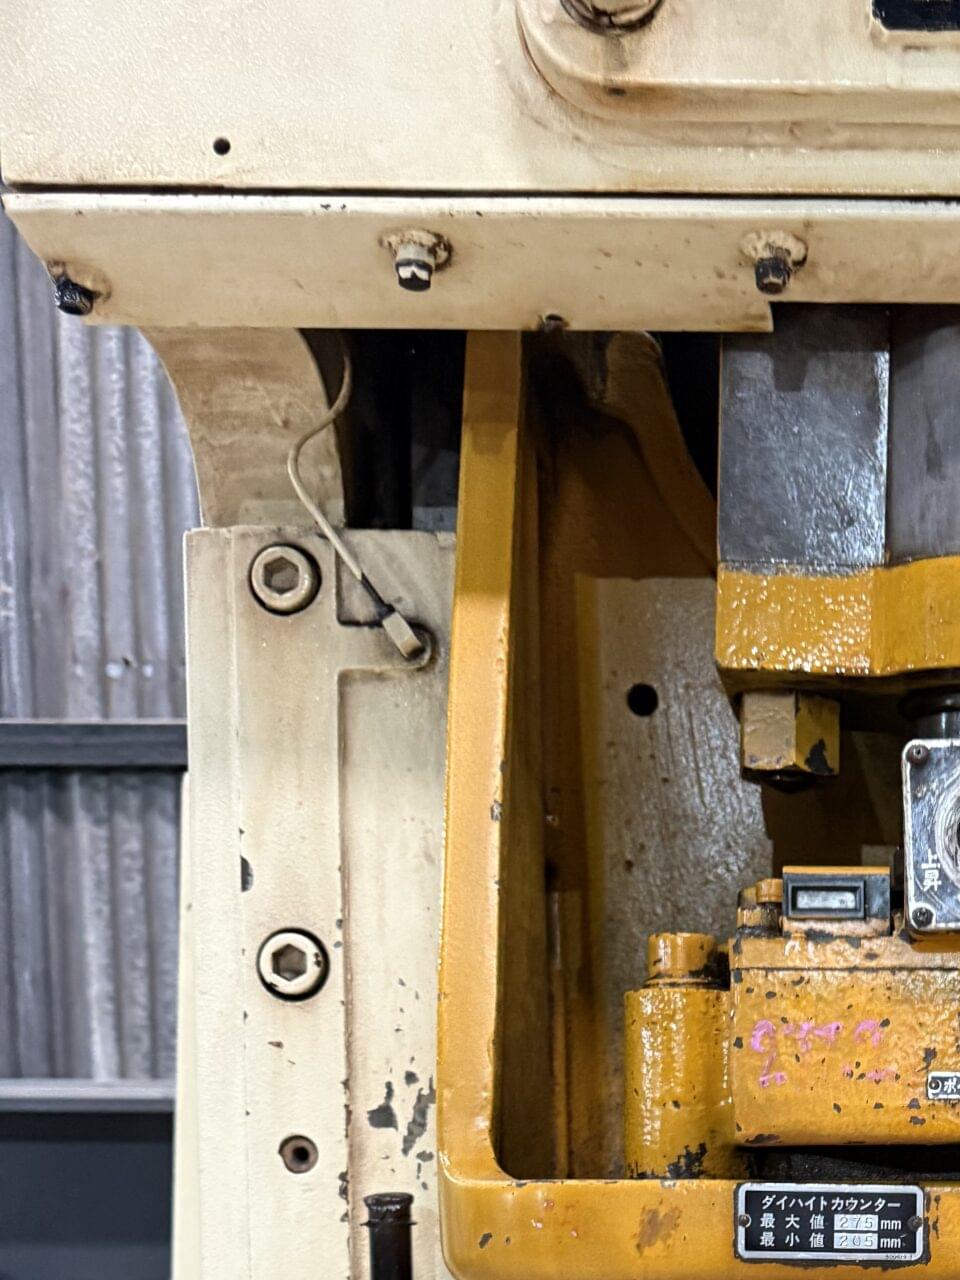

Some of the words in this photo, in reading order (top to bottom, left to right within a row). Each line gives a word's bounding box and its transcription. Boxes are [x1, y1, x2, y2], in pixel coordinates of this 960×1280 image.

[761, 1195, 901, 1212] ダイハイトカウンター
[839, 1216, 873, 1229] 275
[880, 1219, 902, 1230] mm
[880, 1237, 901, 1248] mm
